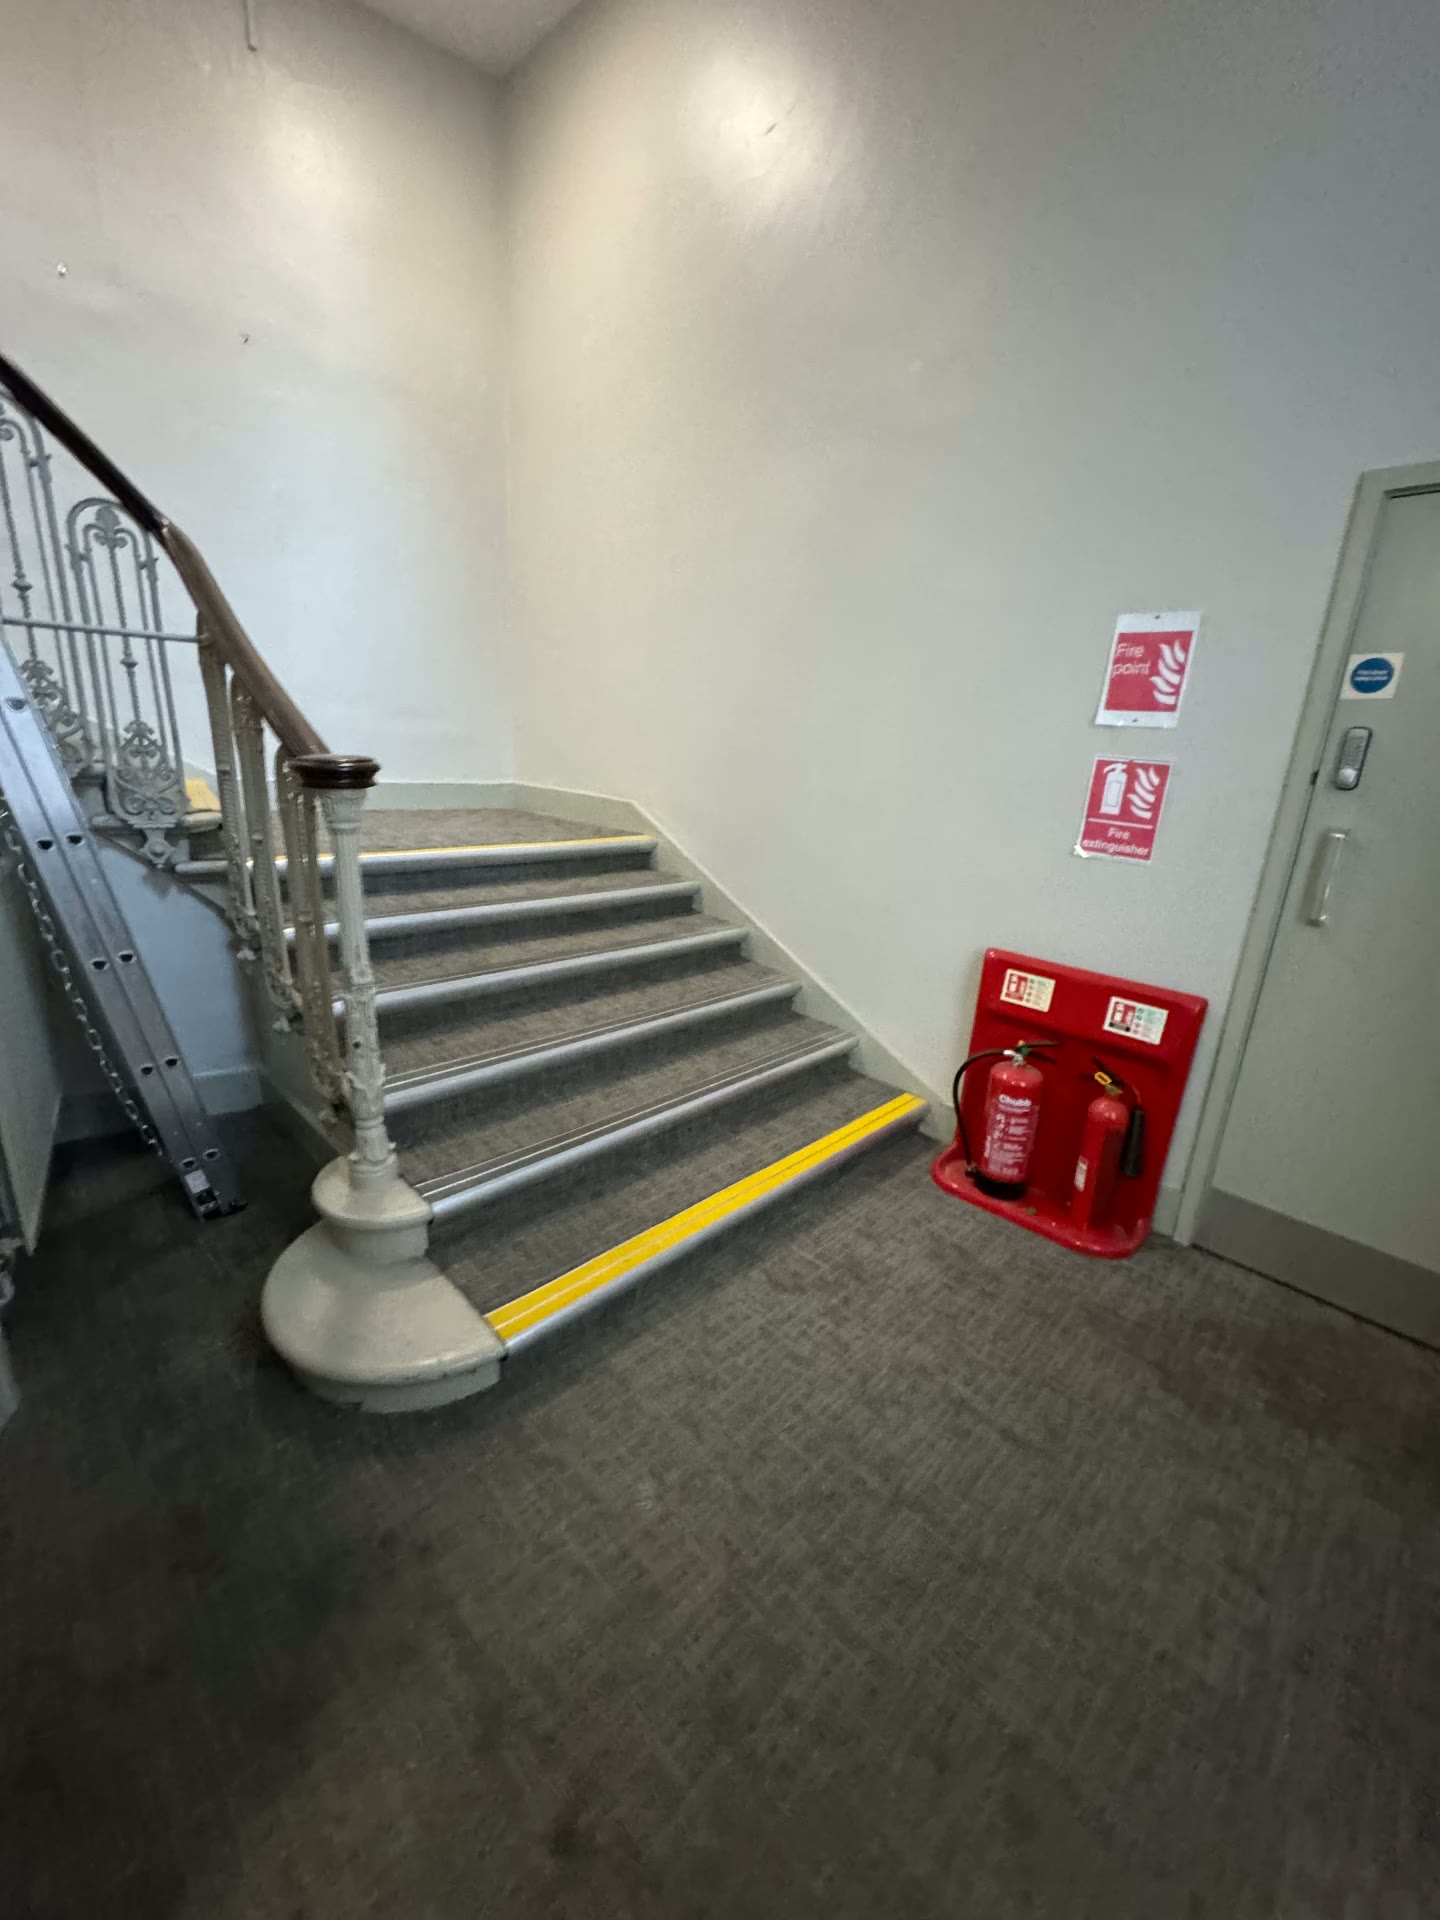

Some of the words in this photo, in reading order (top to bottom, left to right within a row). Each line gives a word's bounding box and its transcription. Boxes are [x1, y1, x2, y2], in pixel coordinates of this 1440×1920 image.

[1116, 643, 1144, 657] Fire
[1112, 660, 1150, 678] point
[1107, 827, 1130, 840] Fire
[1082, 839, 1149, 856] extinguisher
